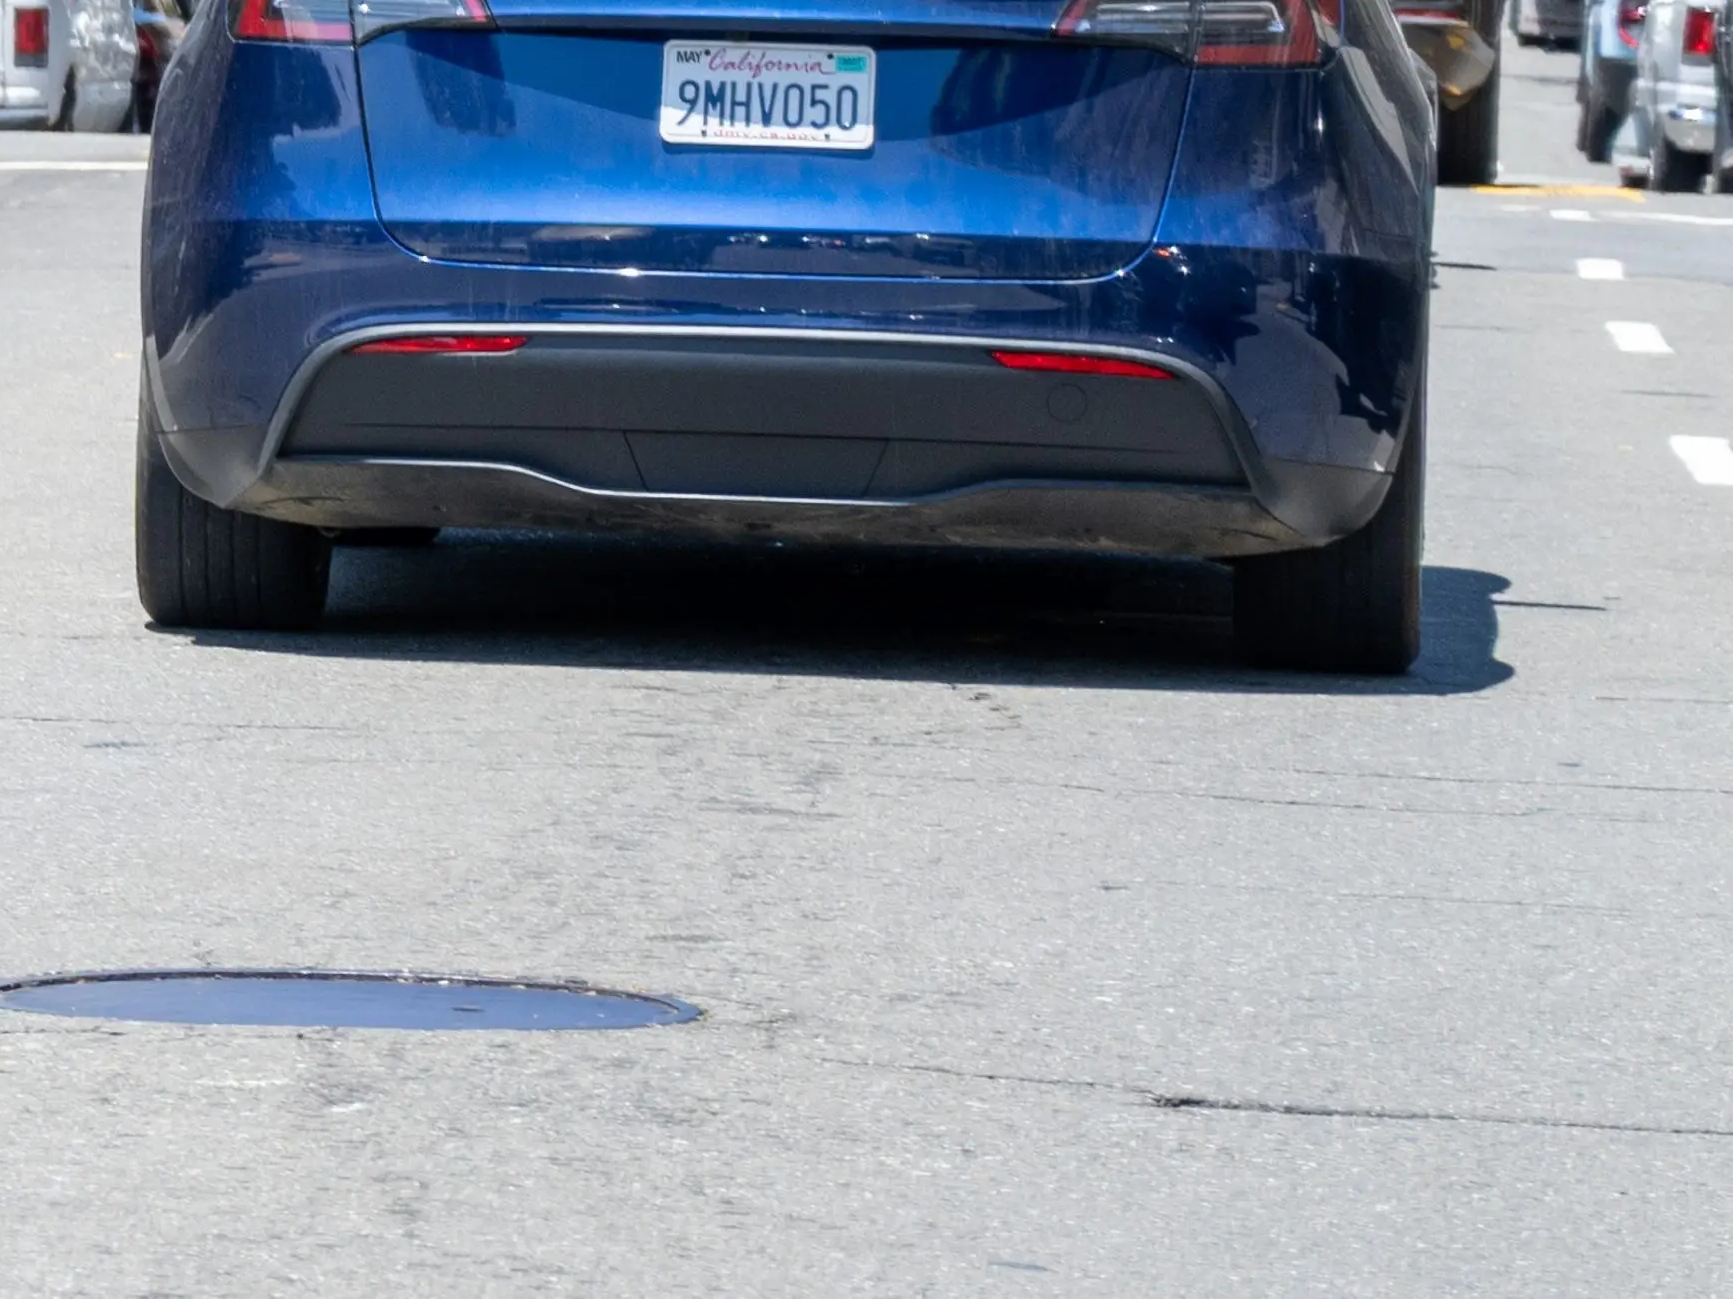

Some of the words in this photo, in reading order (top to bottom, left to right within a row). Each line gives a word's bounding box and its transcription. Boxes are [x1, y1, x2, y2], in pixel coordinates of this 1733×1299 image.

[676, 50, 702, 63] MAY
[708, 47, 835, 78] California
[676, 79, 859, 131] 9MHV050
